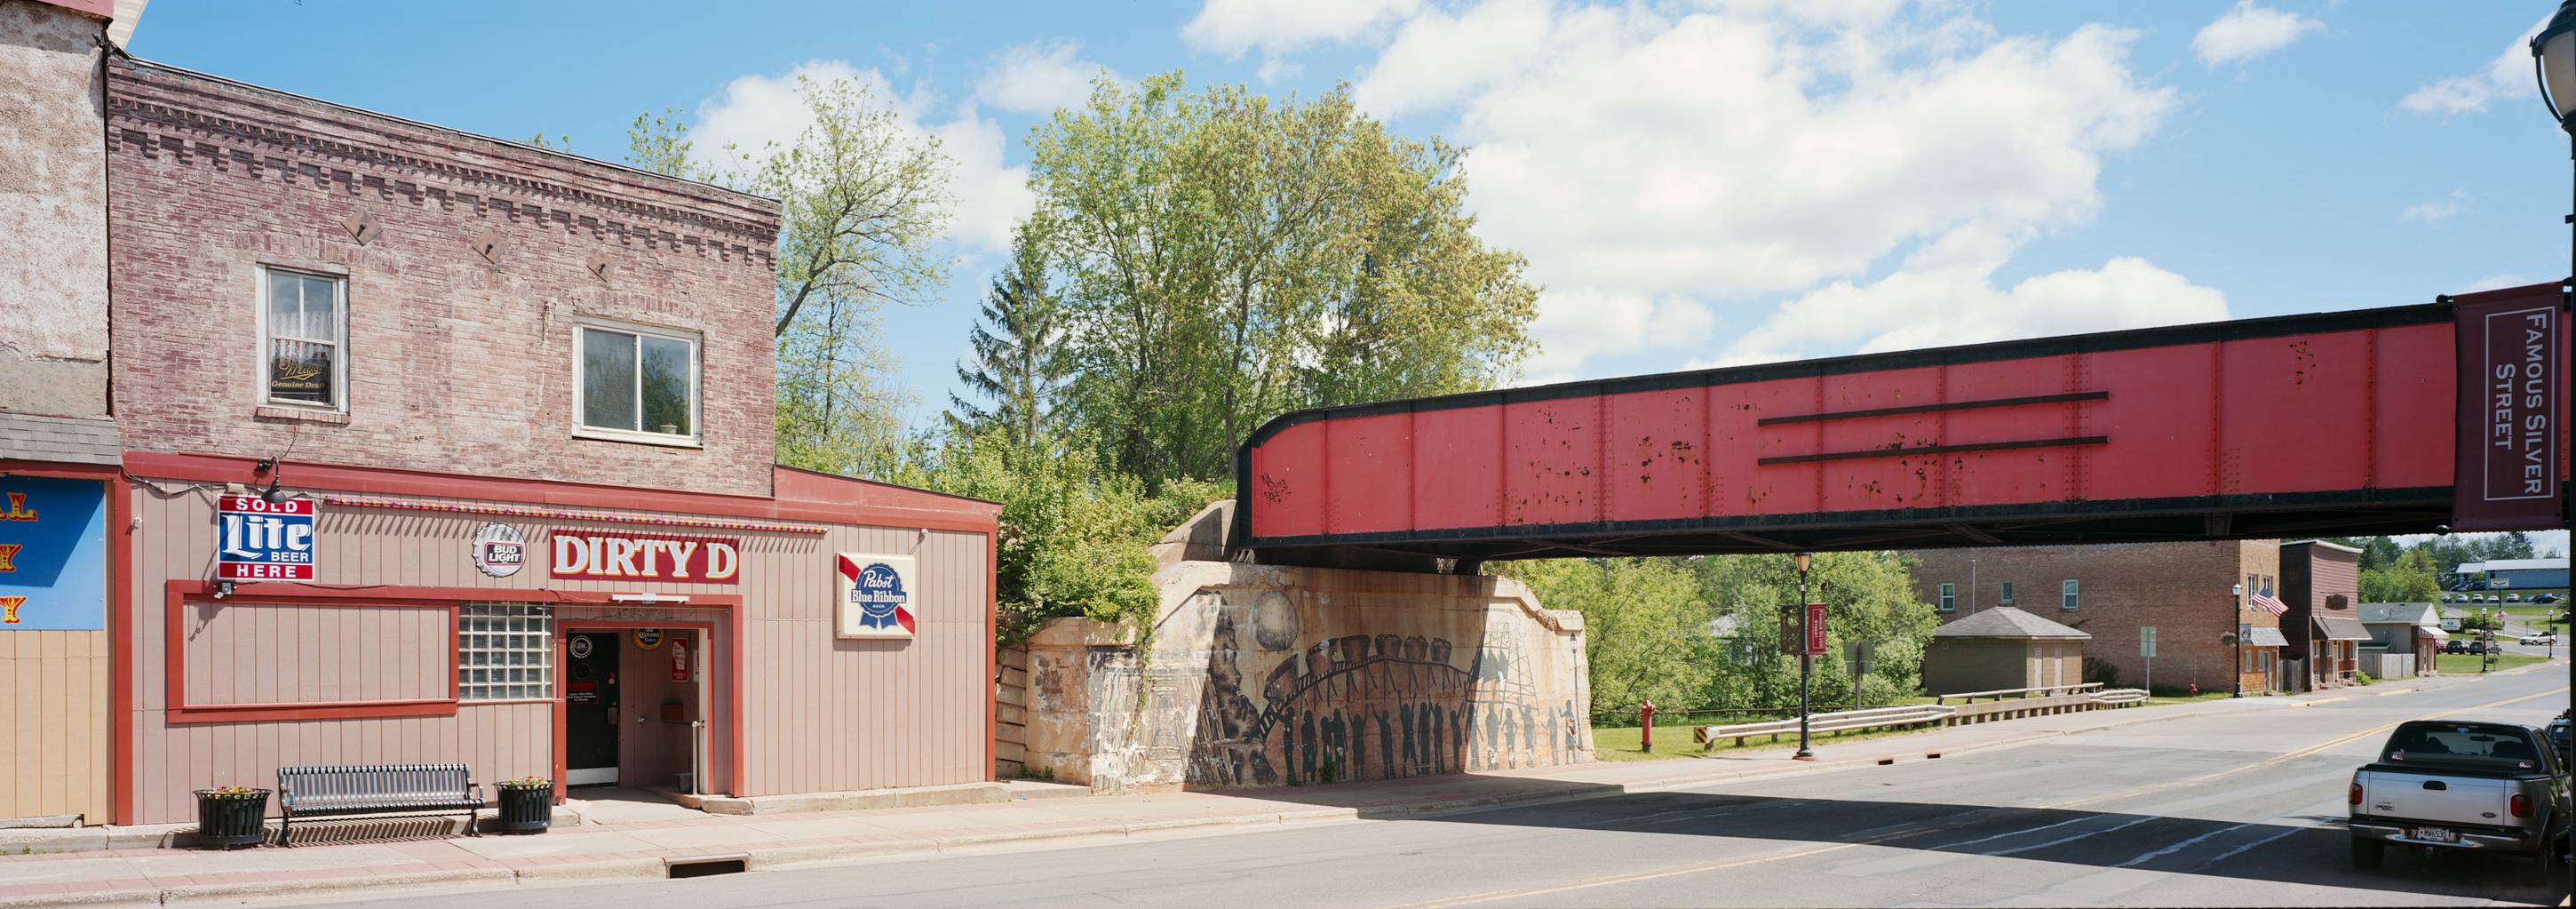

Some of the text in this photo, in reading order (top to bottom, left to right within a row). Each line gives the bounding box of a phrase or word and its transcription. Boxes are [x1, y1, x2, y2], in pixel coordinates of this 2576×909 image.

[2495, 363, 2516, 450] STREET
[2524, 314, 2547, 494] FAMOUS SILVER
[235, 498, 298, 513] SOLD
[220, 514, 312, 560] Lite
[270, 551, 309, 562] BEER
[493, 545, 518, 554] BUD
[553, 535, 738, 579] DIRTY D
[489, 553, 521, 563] LIGHT
[236, 564, 297, 578] HERE
[863, 570, 894, 588] Pabst
[851, 589, 906, 603] Blue Ribbon
